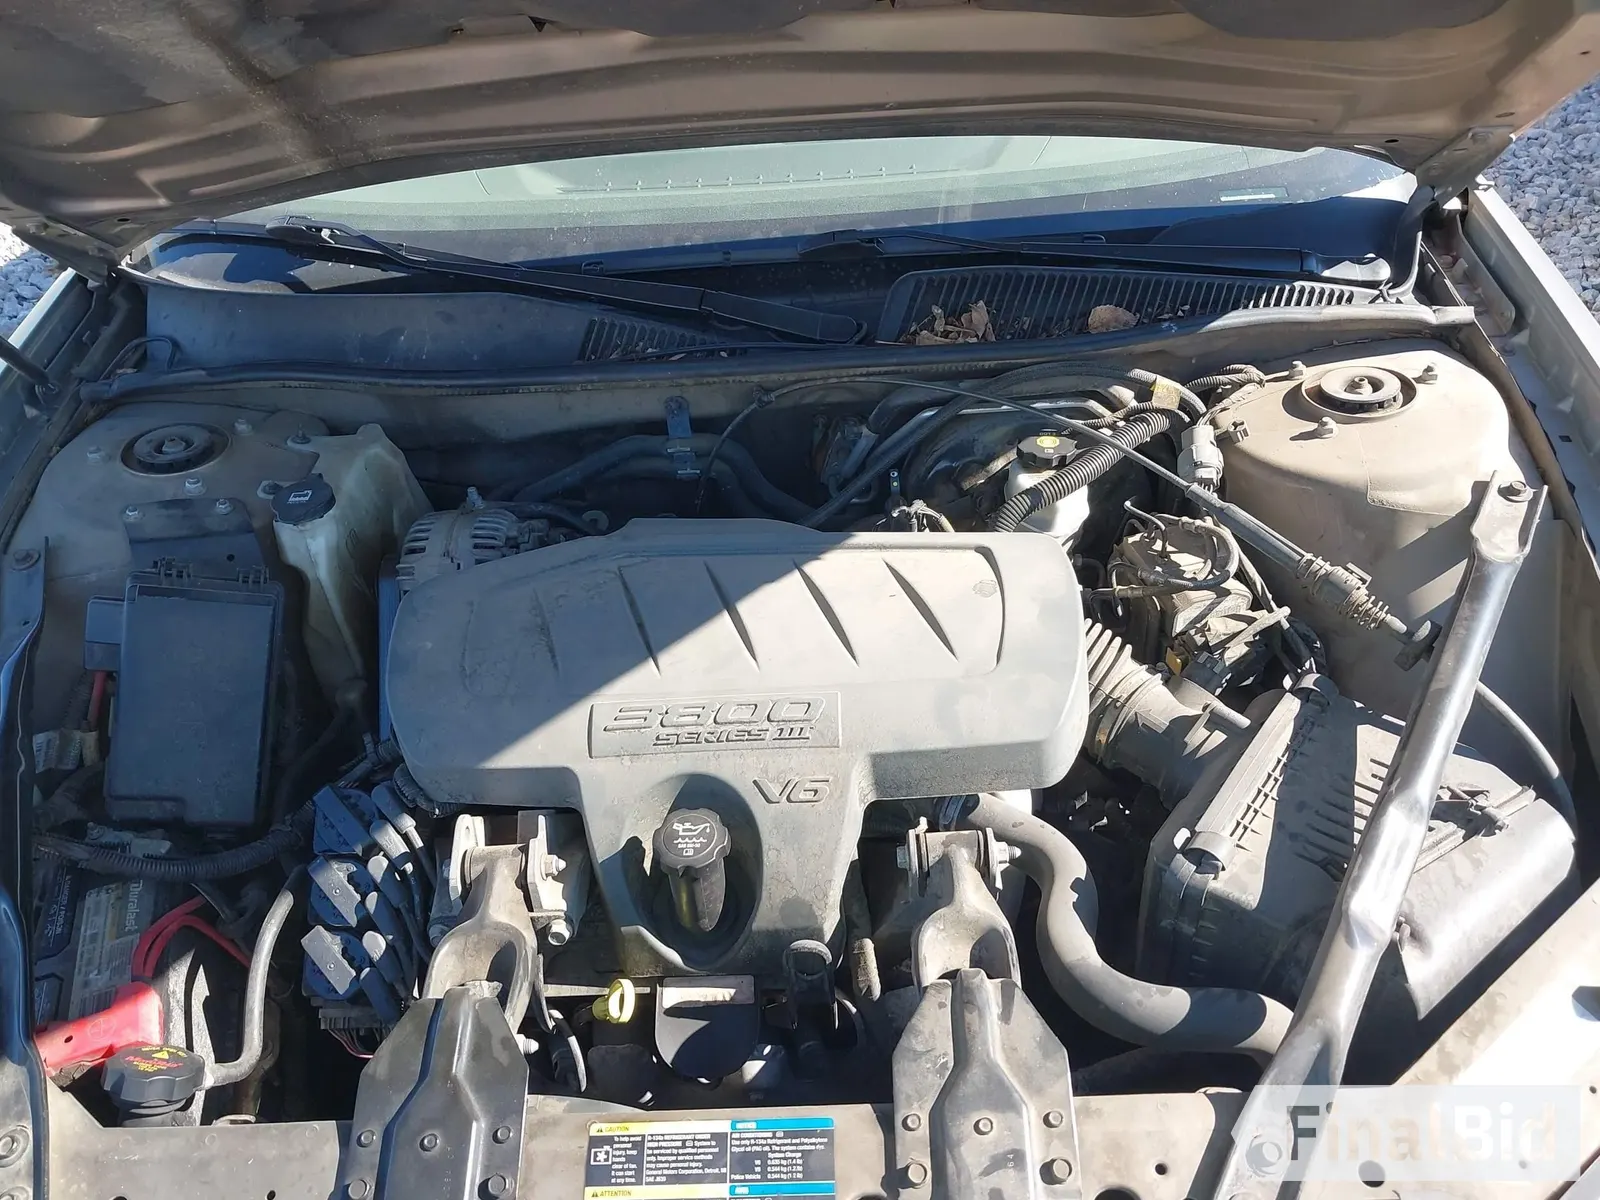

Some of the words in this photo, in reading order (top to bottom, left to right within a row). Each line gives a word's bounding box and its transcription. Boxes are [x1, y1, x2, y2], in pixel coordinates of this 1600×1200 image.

[603, 699, 825, 731] 3800
[653, 728, 769, 746] SERIES
[752, 778, 831, 804] V6
